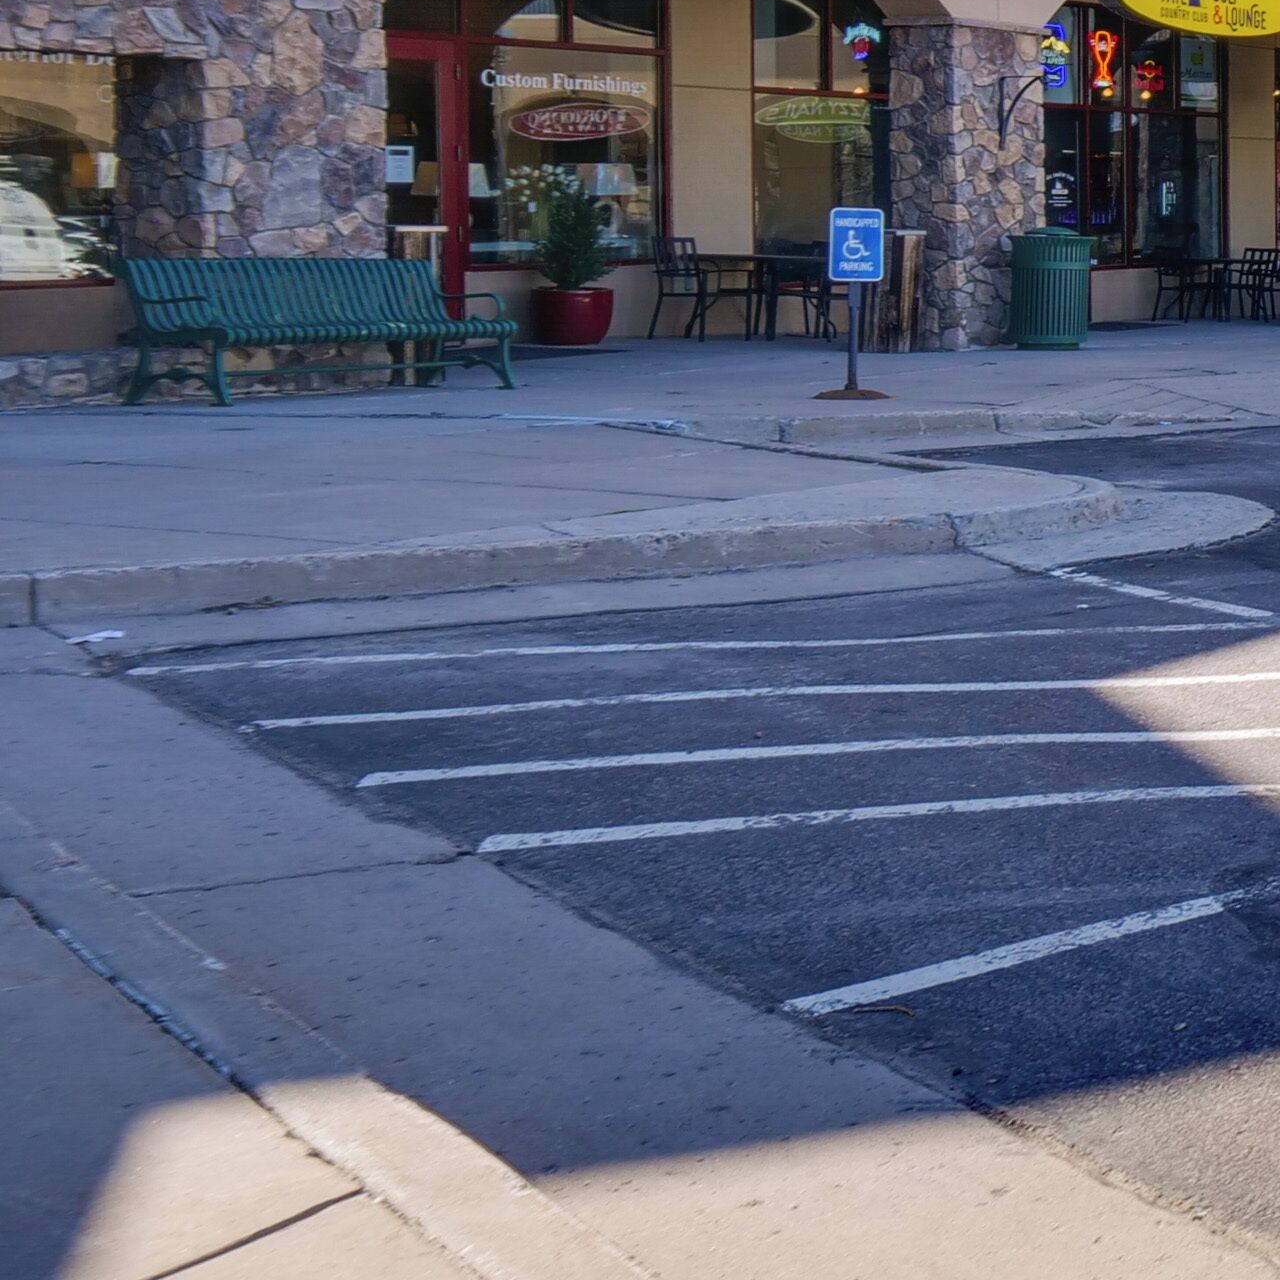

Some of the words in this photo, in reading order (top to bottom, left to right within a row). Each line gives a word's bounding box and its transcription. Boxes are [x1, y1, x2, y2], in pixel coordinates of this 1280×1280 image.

[1160, 5, 1190, 21] COUNTRY
[1192, 11, 1208, 23] CLUB
[1212, 5, 1223, 24] &
[1225, 4, 1267, 32] LOUNGE
[480, 69, 548, 89] Custom
[552, 73, 648, 97] Furnishings
[834, 218, 879, 228] HANDICAPPED
[839, 262, 874, 271] PARKING
